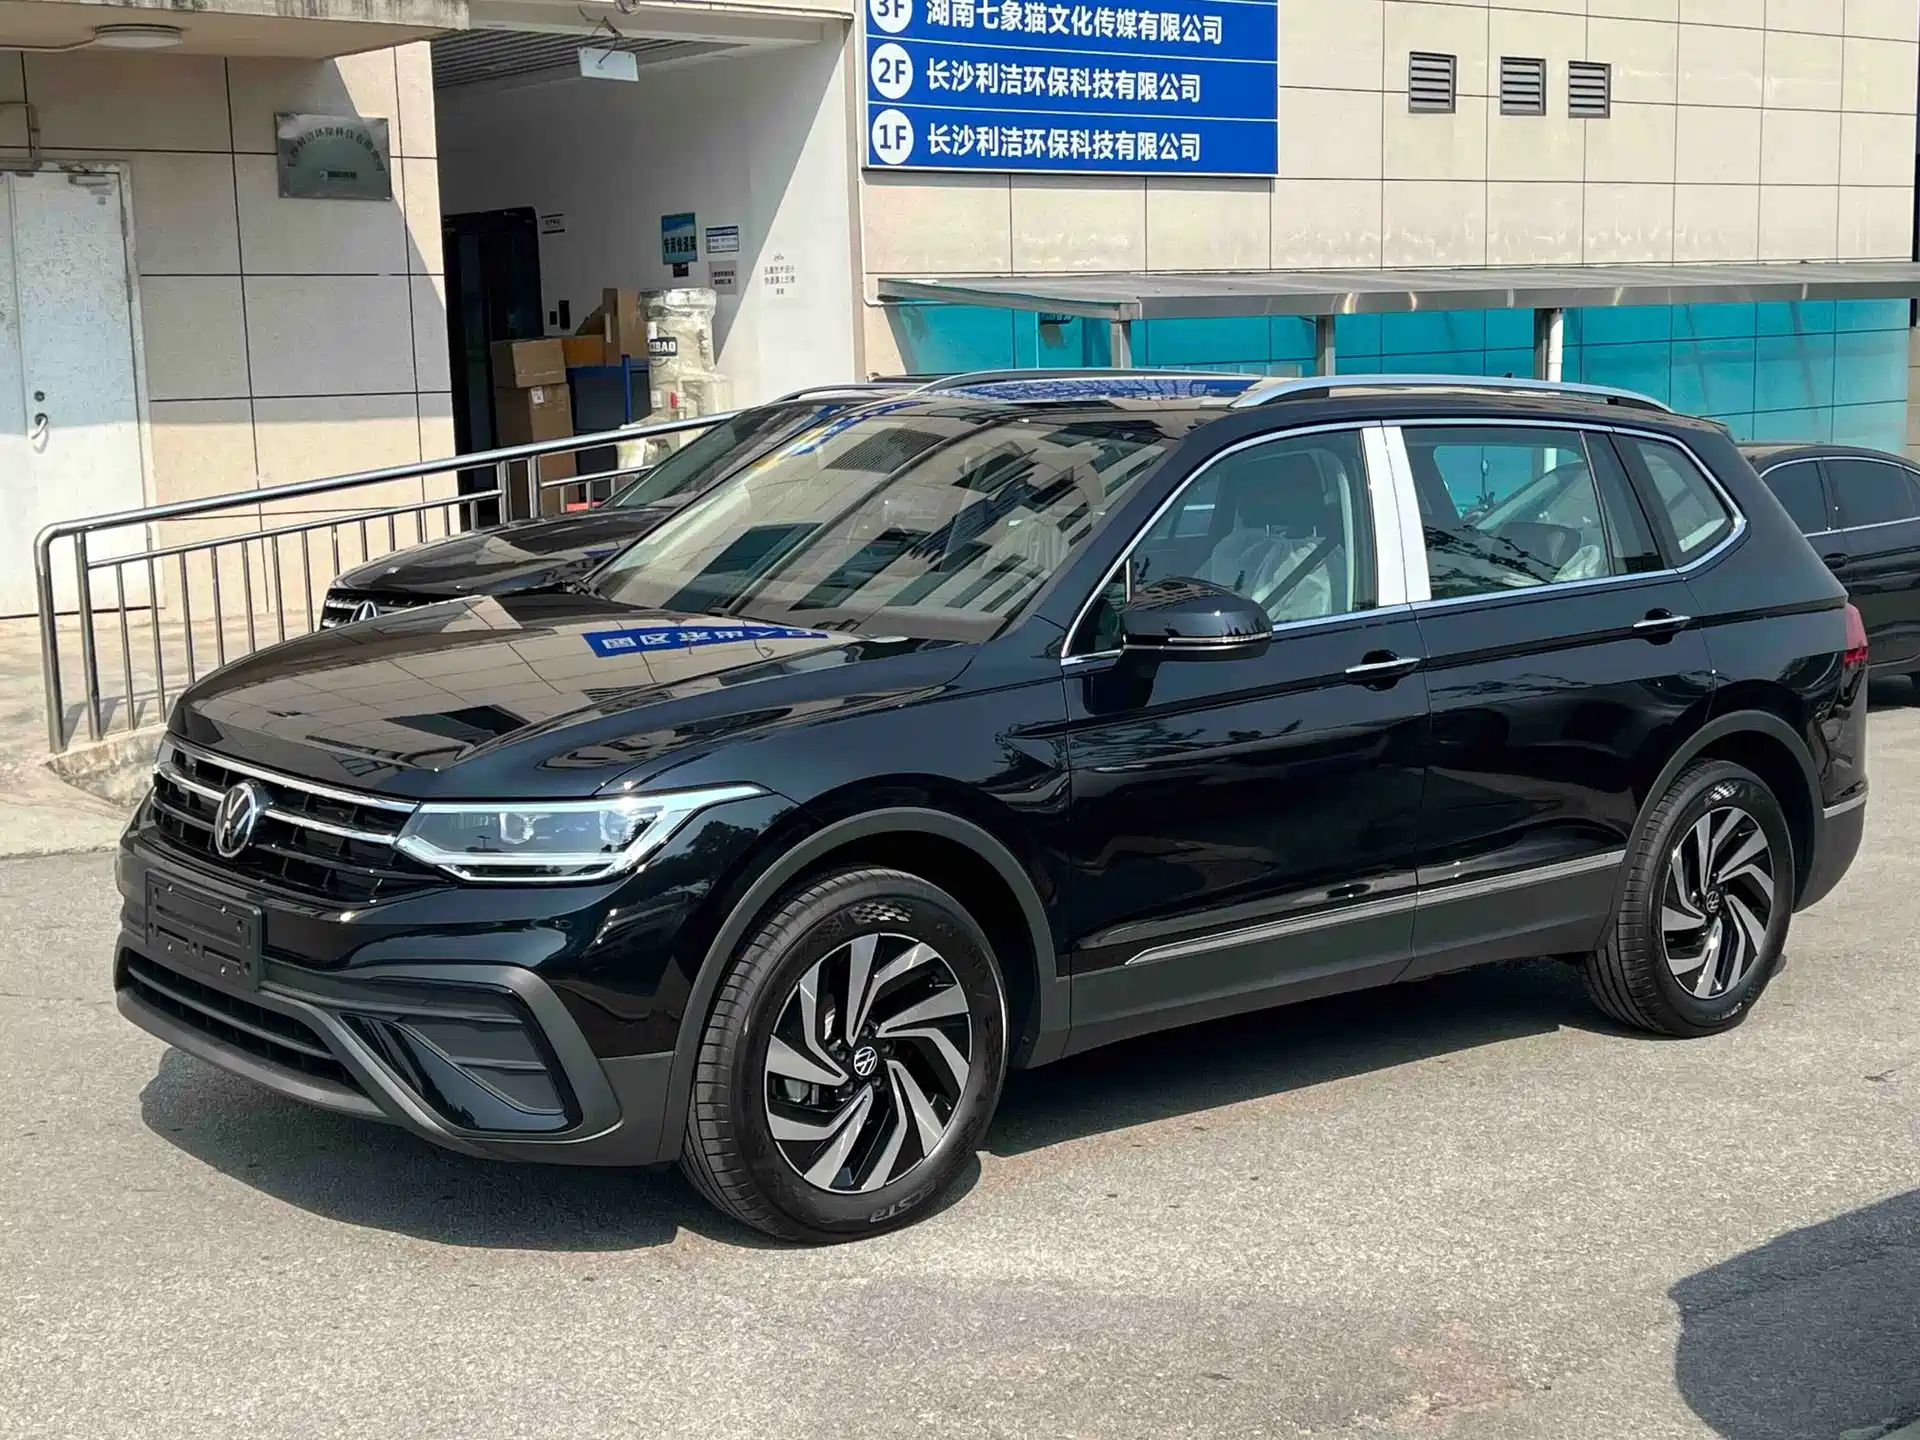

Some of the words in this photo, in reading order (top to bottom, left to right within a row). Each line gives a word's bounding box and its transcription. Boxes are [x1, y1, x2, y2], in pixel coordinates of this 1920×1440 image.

[877, 0, 905, 18] 3F
[926, 0, 1222, 45] 湖南七象猫文化传媒有限公司
[878, 57, 907, 84] 2F
[926, 58, 1200, 103] 长沙利洁环保科技有限公司
[879, 123, 907, 150] 1F
[927, 123, 1200, 161] 长沙利洁环保科技有限公司
